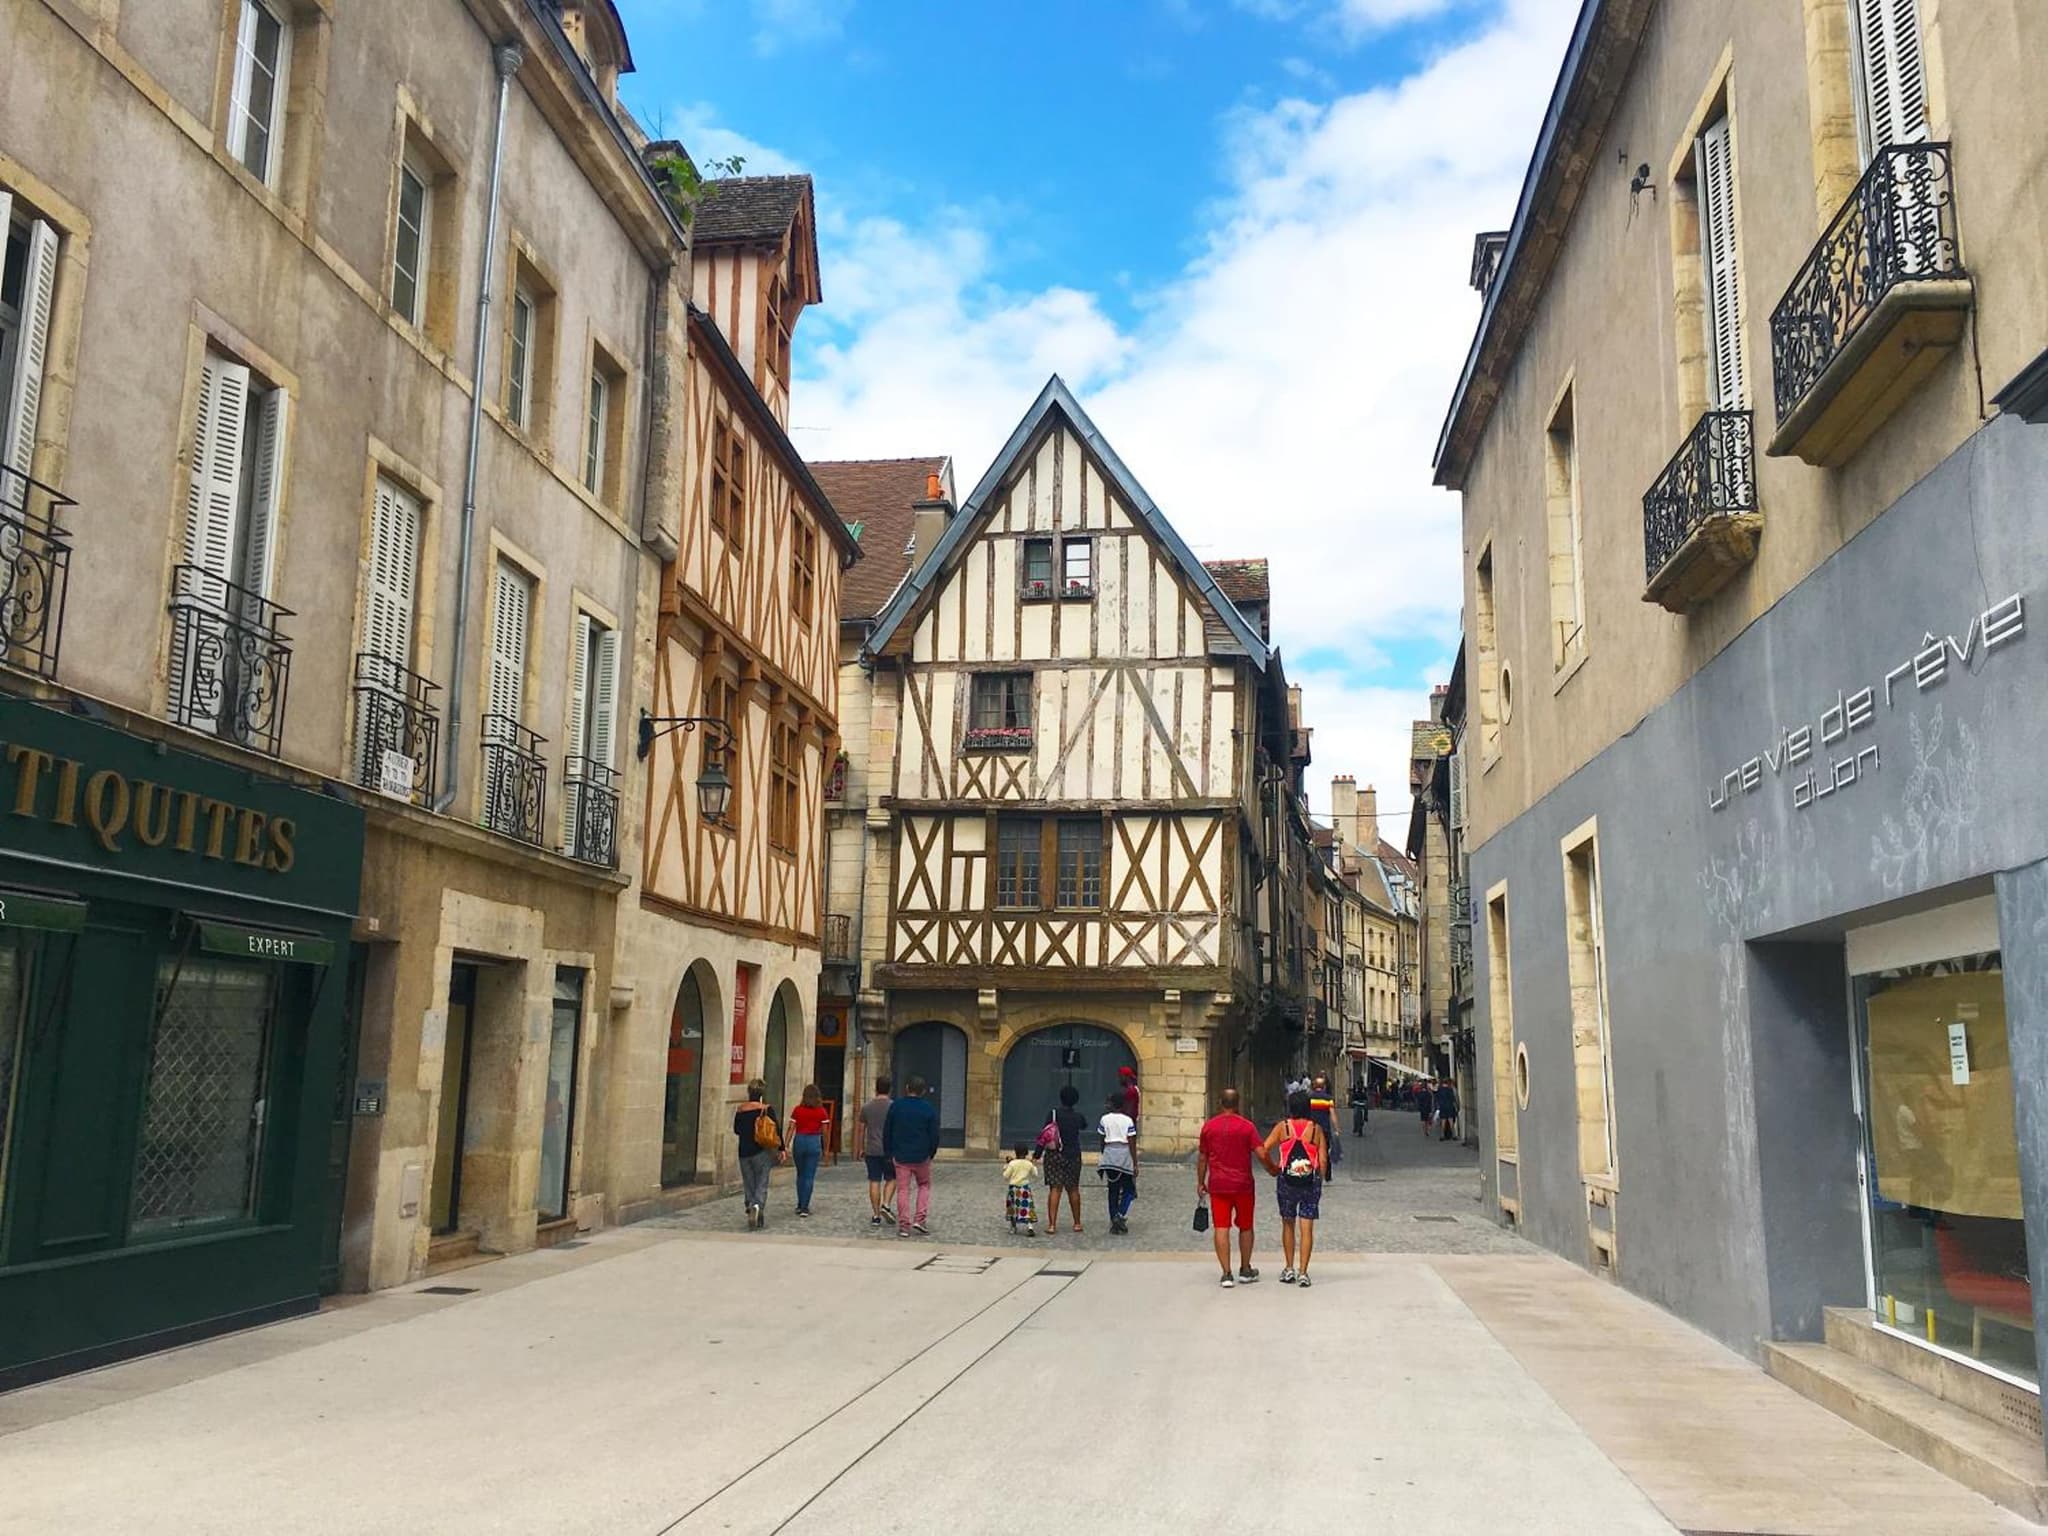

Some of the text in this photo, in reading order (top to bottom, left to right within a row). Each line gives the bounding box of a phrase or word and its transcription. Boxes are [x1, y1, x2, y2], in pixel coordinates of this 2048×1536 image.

[1708, 592, 2025, 809] une vie de rêve
[0, 741, 296, 873] TIQUITES
[1793, 745, 1880, 808] dijon
[248, 935, 295, 957] EXPERT
